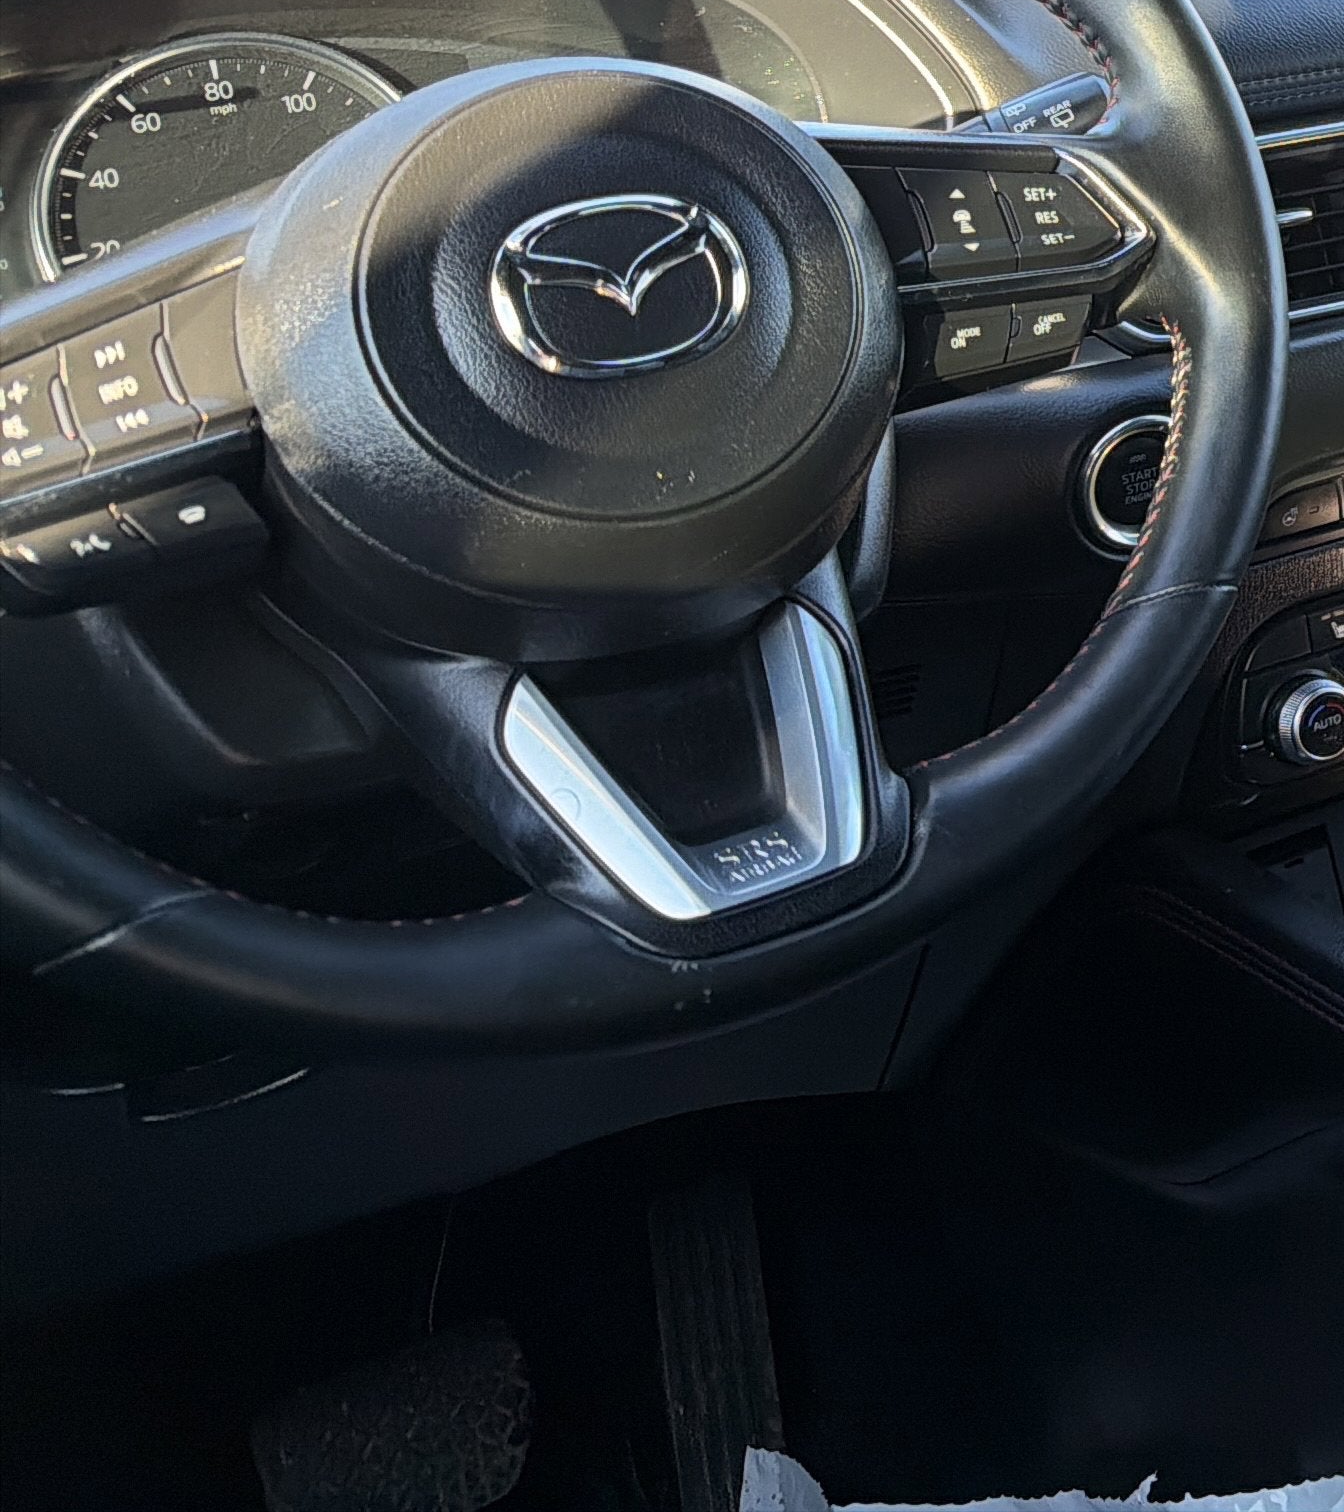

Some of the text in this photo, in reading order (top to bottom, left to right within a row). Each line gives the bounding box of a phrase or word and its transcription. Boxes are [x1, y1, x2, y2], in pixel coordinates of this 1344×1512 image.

[203, 80, 233, 102] 80
[209, 103, 238, 117] mph
[281, 92, 317, 114] 100
[1042, 99, 1072, 118] REAR
[130, 112, 162, 134] 60
[1013, 116, 1037, 134] OFF
[88, 167, 119, 189] 40
[1023, 187, 1057, 202] SET+
[1034, 210, 1059, 225] RES
[1038, 312, 1066, 324] CANCEL
[957, 326, 981, 338] MODE
[1033, 322, 1052, 336] OFF
[950, 336, 967, 349] ON
[1121, 467, 1158, 485] START
[1125, 490, 1152, 505] ENGIN
[1313, 713, 1342, 733] AUTO
